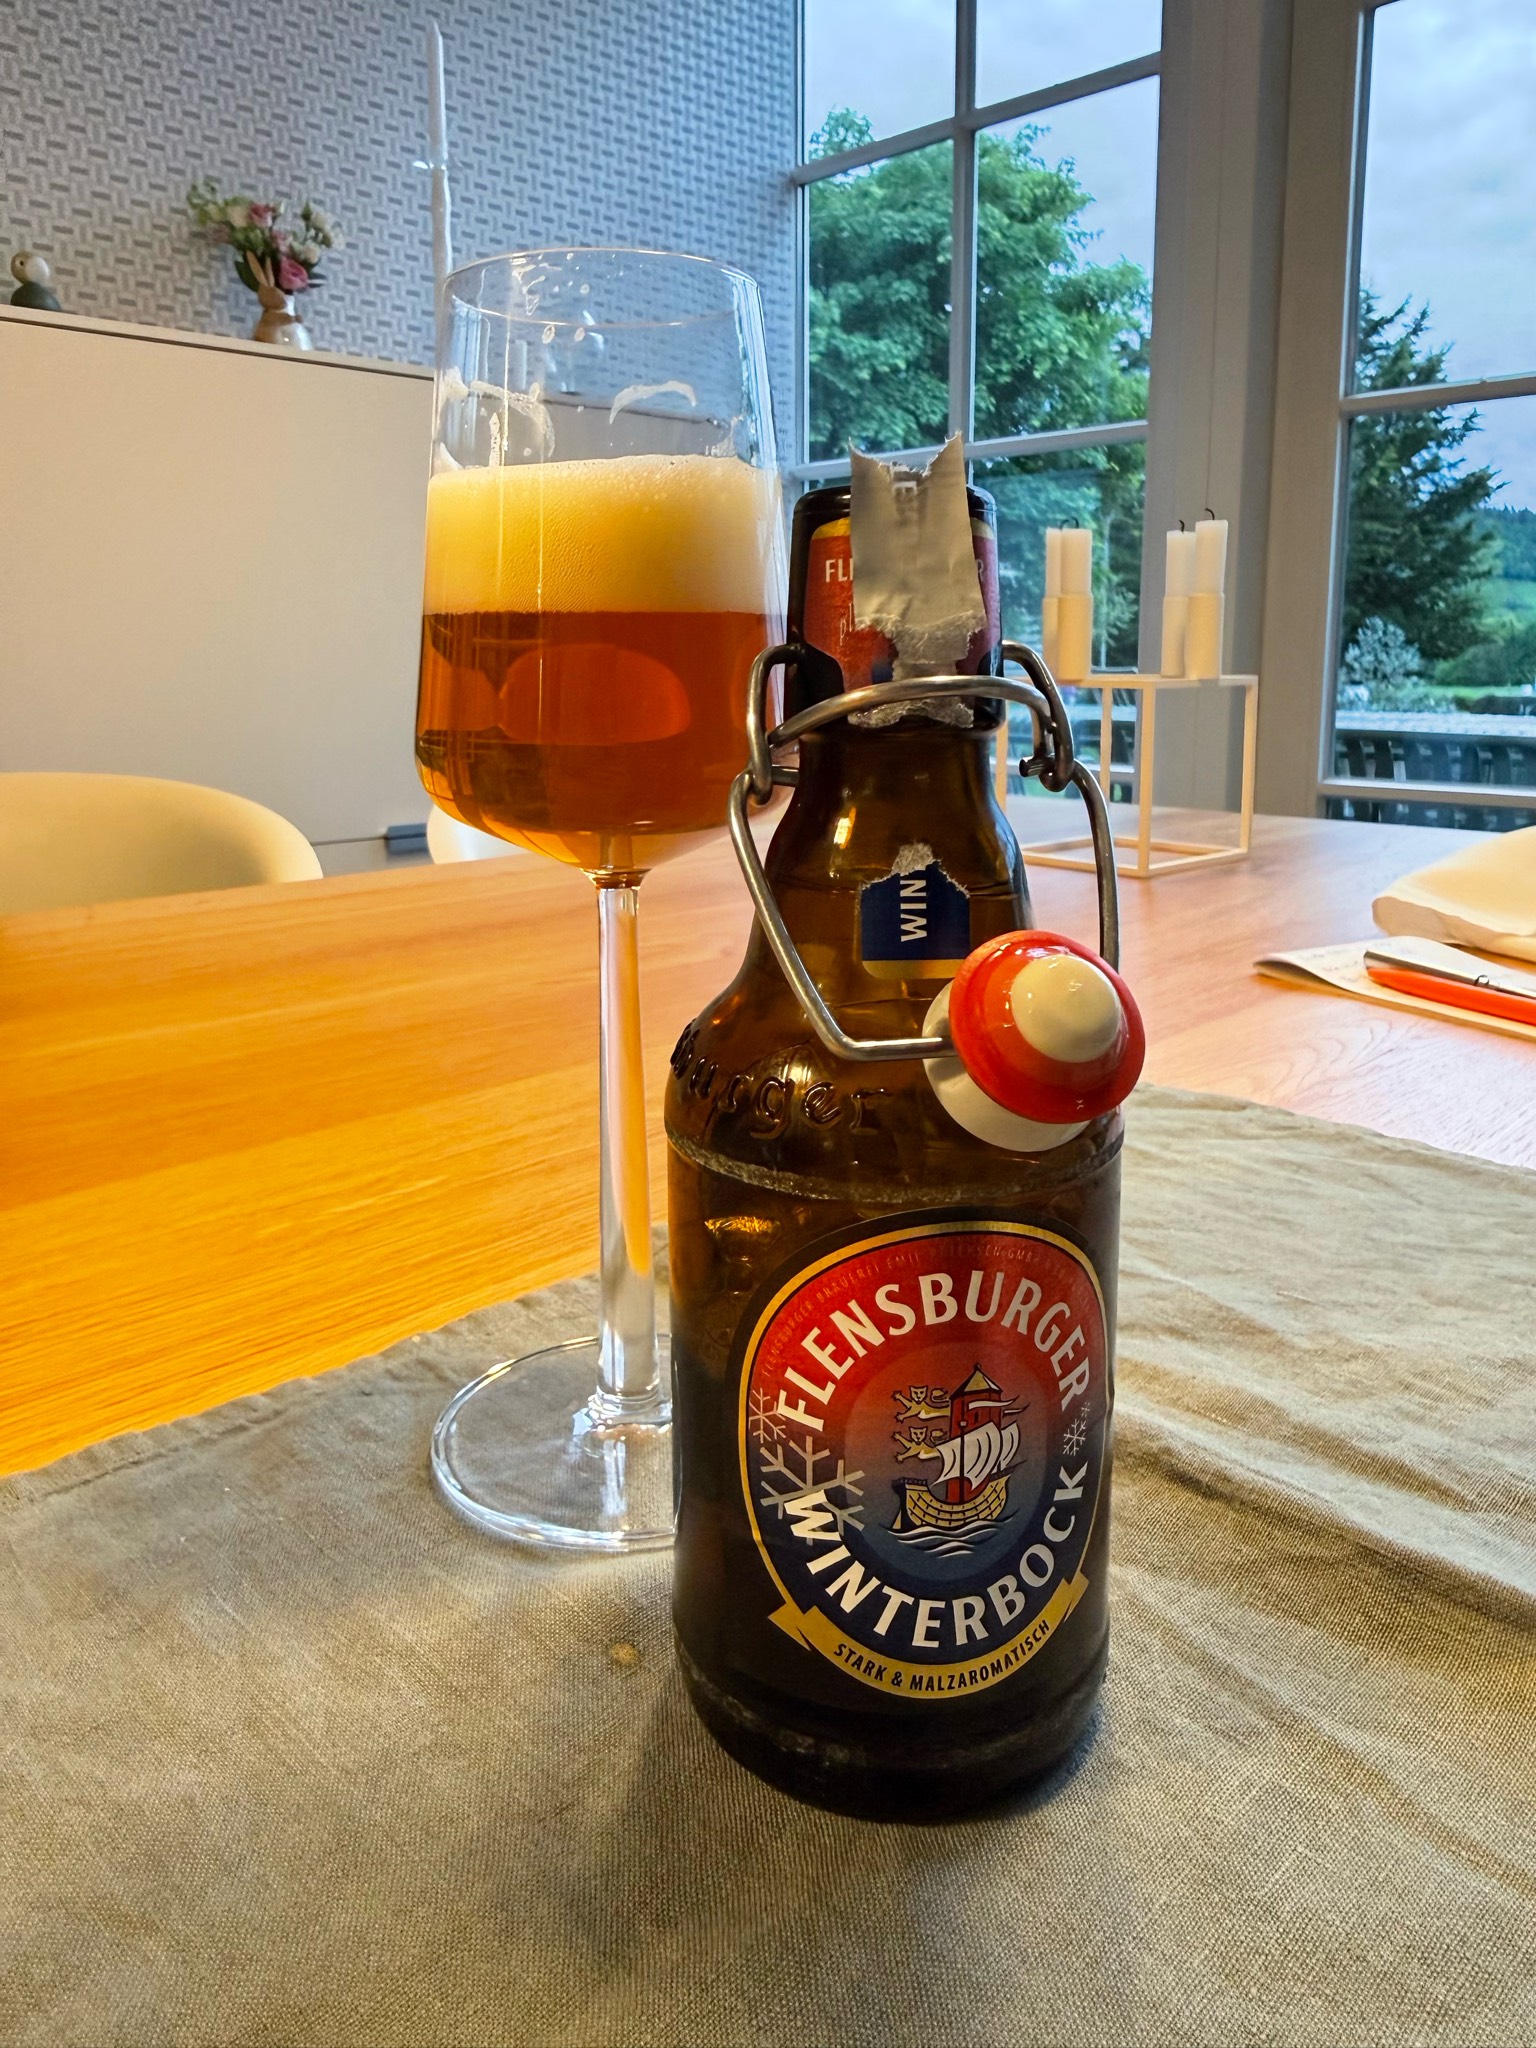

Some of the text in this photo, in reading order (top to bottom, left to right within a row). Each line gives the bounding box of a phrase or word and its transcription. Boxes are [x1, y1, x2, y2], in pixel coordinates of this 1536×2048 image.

[900, 879, 928, 943] WIN
[777, 1270, 1090, 1432] FLENSBURGER
[784, 1461, 1088, 1648] WINTERBOCK
[834, 1619, 1051, 1692] STARK & MALZAROMATISCH
